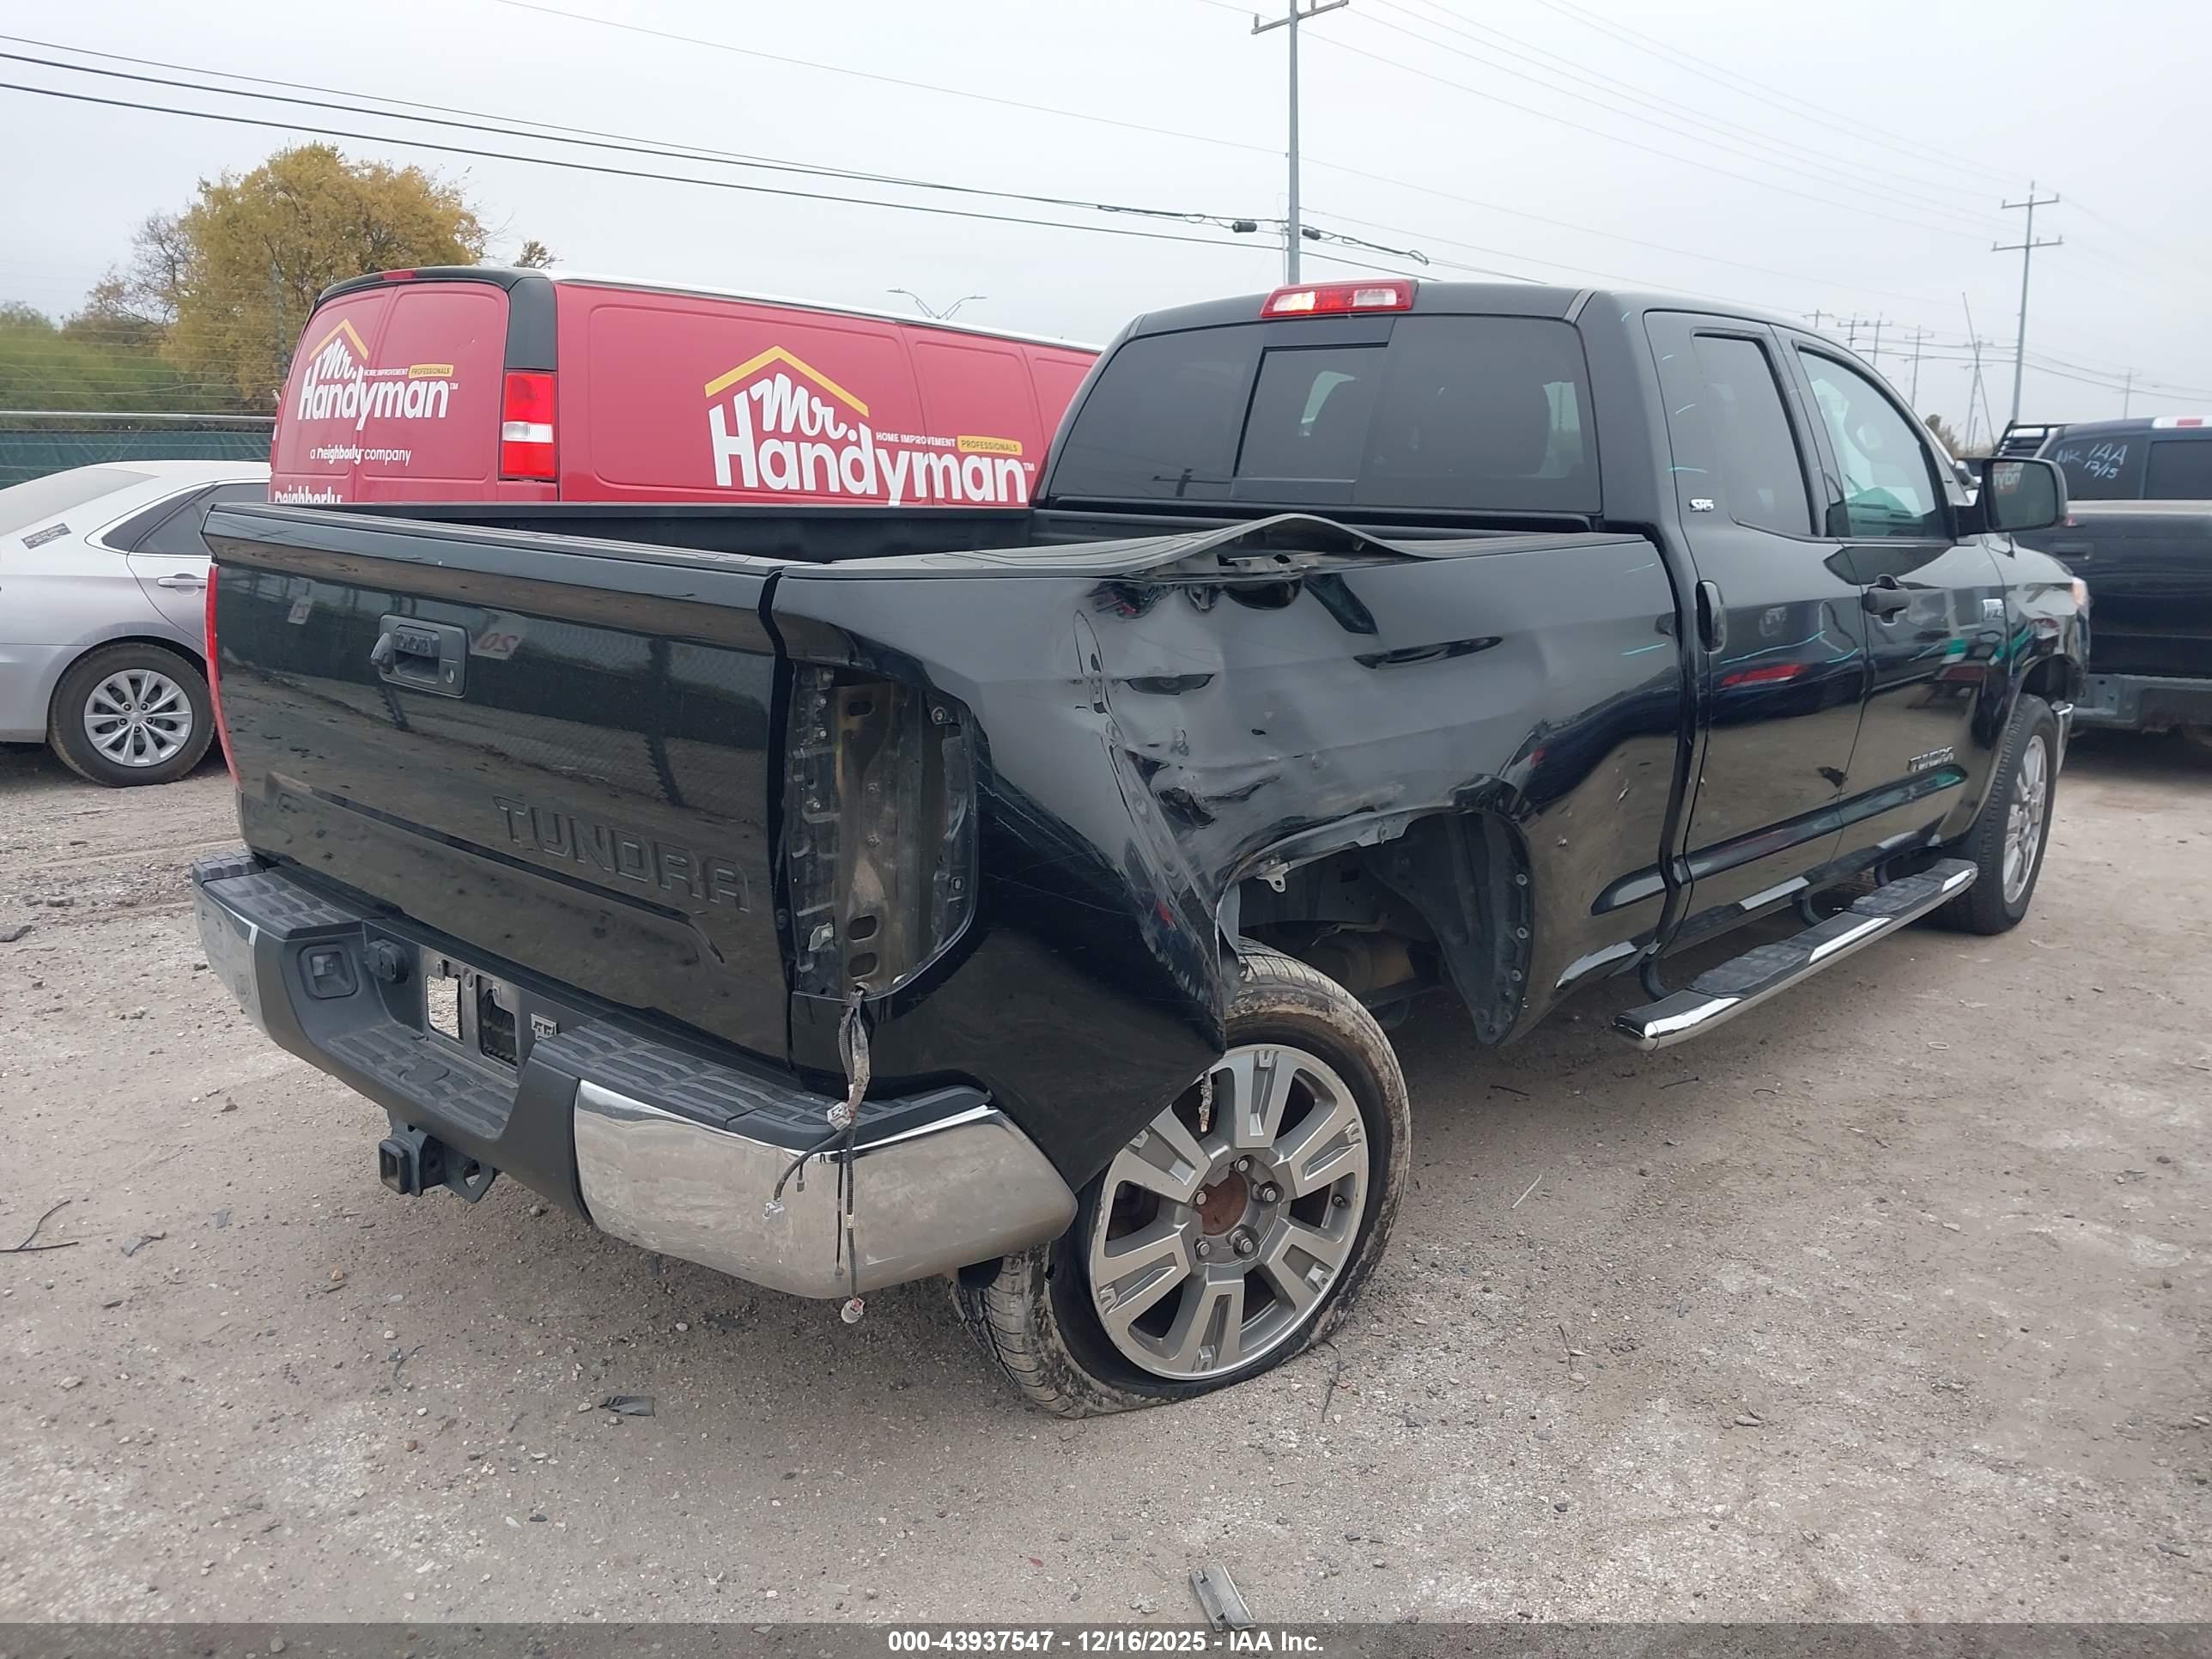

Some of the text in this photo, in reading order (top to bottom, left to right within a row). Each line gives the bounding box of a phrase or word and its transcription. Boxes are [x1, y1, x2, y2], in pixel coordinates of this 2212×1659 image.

[320, 337, 357, 380] Mr.
[297, 354, 450, 431] Handyman
[750, 373, 857, 442] Mr.
[310, 444, 412, 467] a neighborly company
[708, 388, 1028, 507] Handyman
[876, 432, 1018, 452] HOME IMPROVEMENT PROFESSIONALS
[2088, 442, 2128, 465] IAA
[2084, 460, 2119, 478] 12/15
[492, 794, 750, 913] TUNDRA
